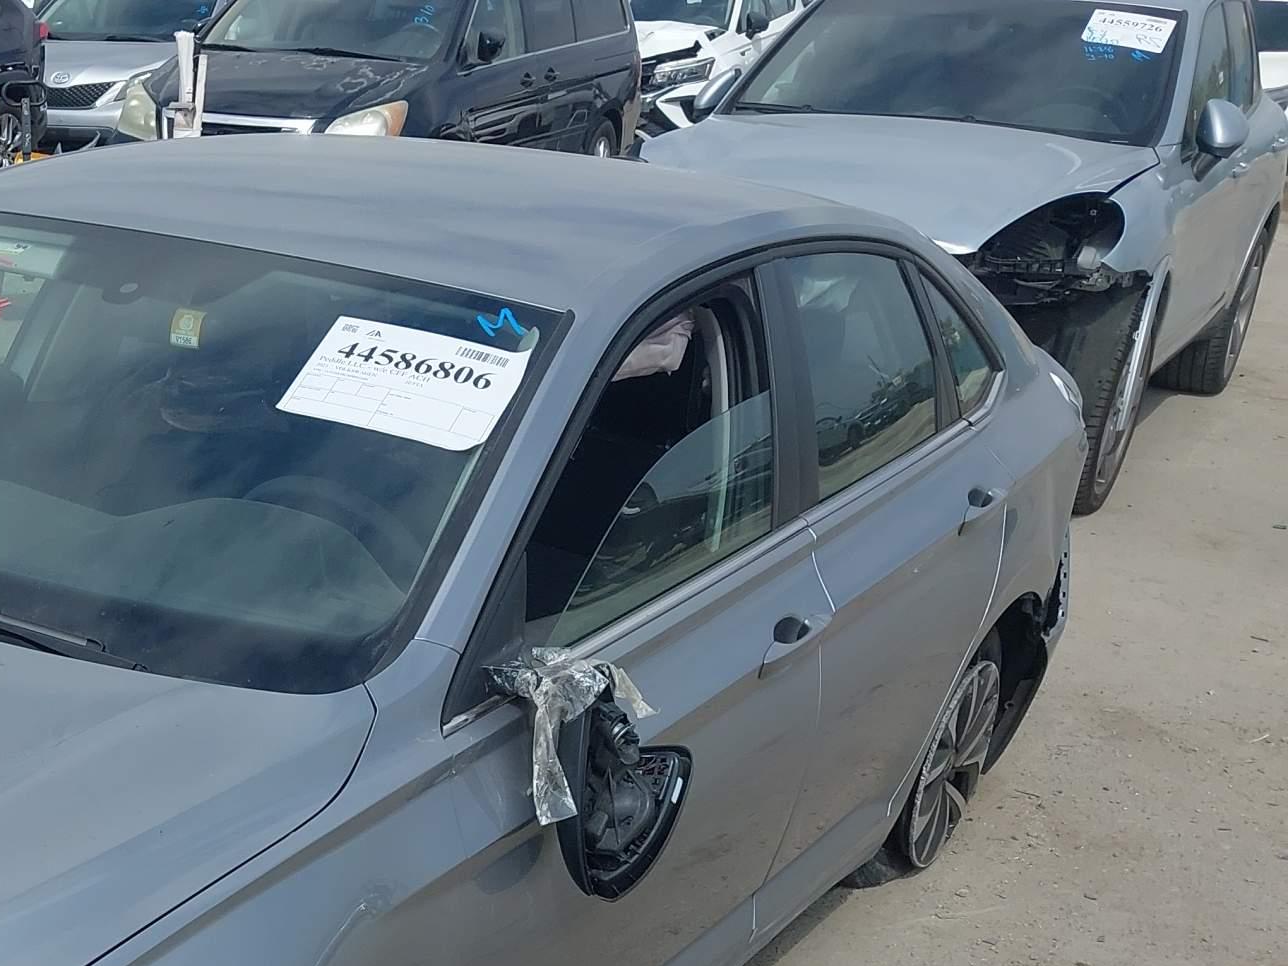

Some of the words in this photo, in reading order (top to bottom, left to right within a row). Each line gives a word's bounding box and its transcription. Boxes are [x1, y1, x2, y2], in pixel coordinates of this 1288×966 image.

[1098, 17, 1163, 32] 44559726
[476, 307, 526, 338] M
[337, 341, 498, 390] 44586806
